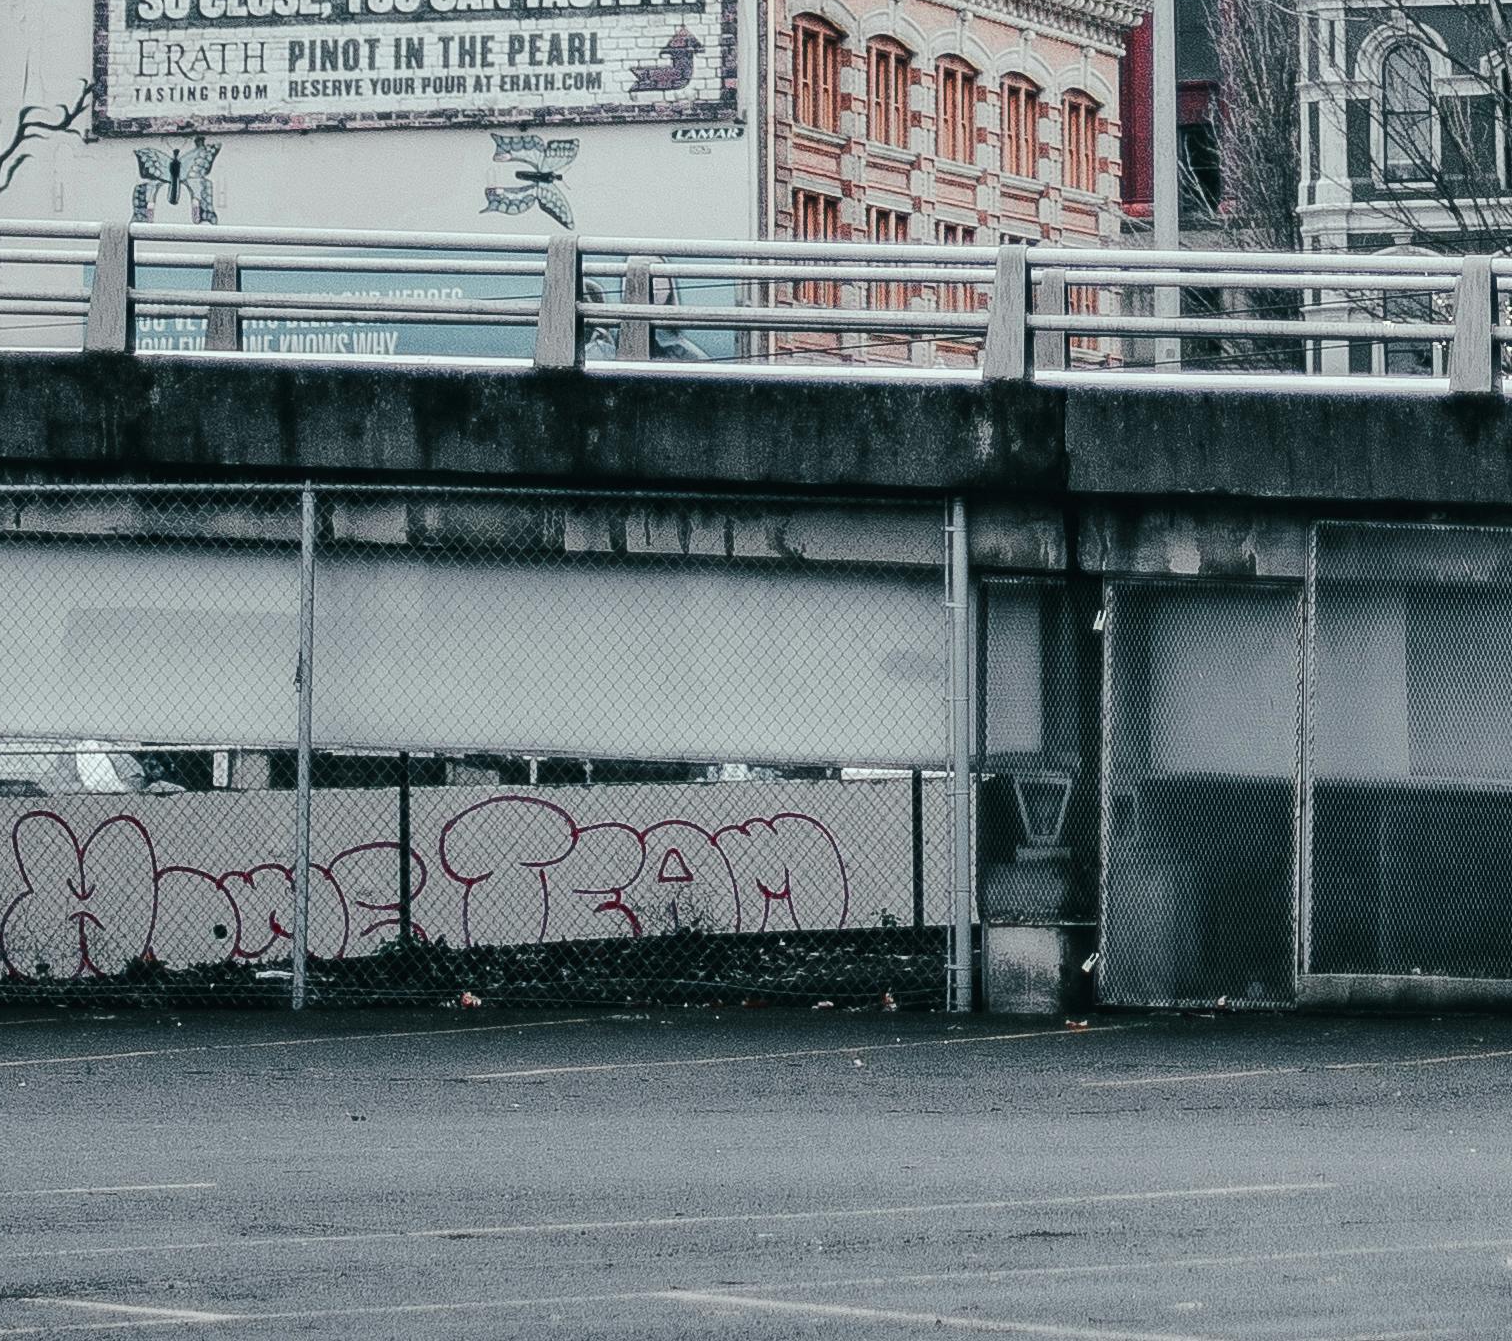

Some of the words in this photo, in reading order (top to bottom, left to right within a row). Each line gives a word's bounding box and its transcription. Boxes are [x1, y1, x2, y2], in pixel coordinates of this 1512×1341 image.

[137, 39, 269, 82] ERATH
[288, 37, 380, 72] PINOT
[393, 36, 425, 70] IN
[438, 34, 495, 68] THE
[508, 31, 605, 67] PEARL
[135, 86, 209, 103] TASTING
[219, 84, 268, 100] ROOM
[288, 78, 363, 99] RESERVE
[369, 75, 415, 96] YOUR
[421, 74, 467, 95] POUR
[472, 75, 494, 94] AT
[499, 71, 602, 93] ERATH.COM
[676, 128, 739, 139] LAMAR
